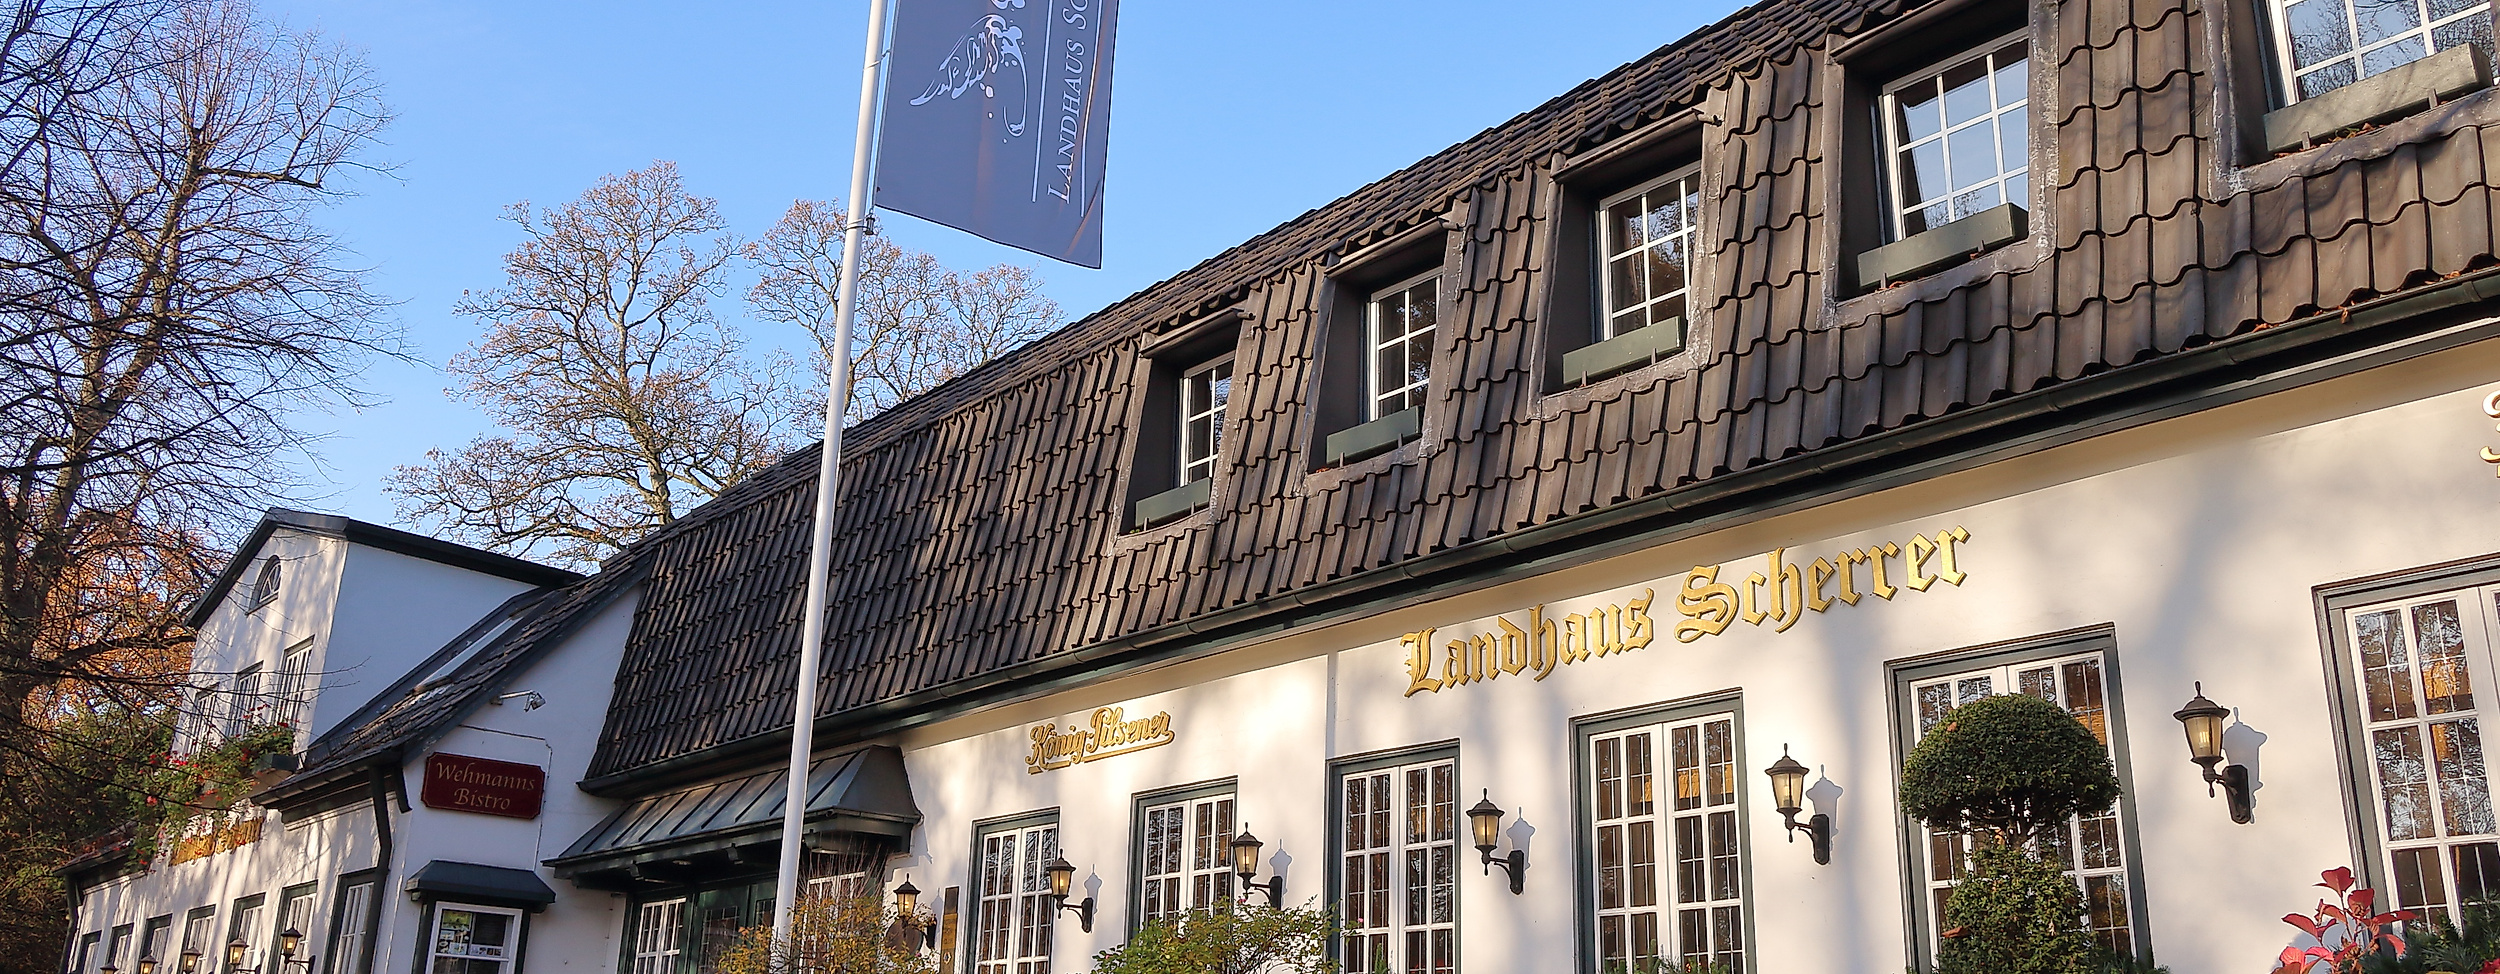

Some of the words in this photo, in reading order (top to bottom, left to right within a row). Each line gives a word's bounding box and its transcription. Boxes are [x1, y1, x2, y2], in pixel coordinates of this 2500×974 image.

[1047, 38, 1085, 205] LANDHAUS
[1399, 587, 1655, 698] Landhaus
[1674, 524, 1970, 644] Scherrer
[436, 761, 536, 792] Wehmanns
[453, 787, 511, 811] Bistro
